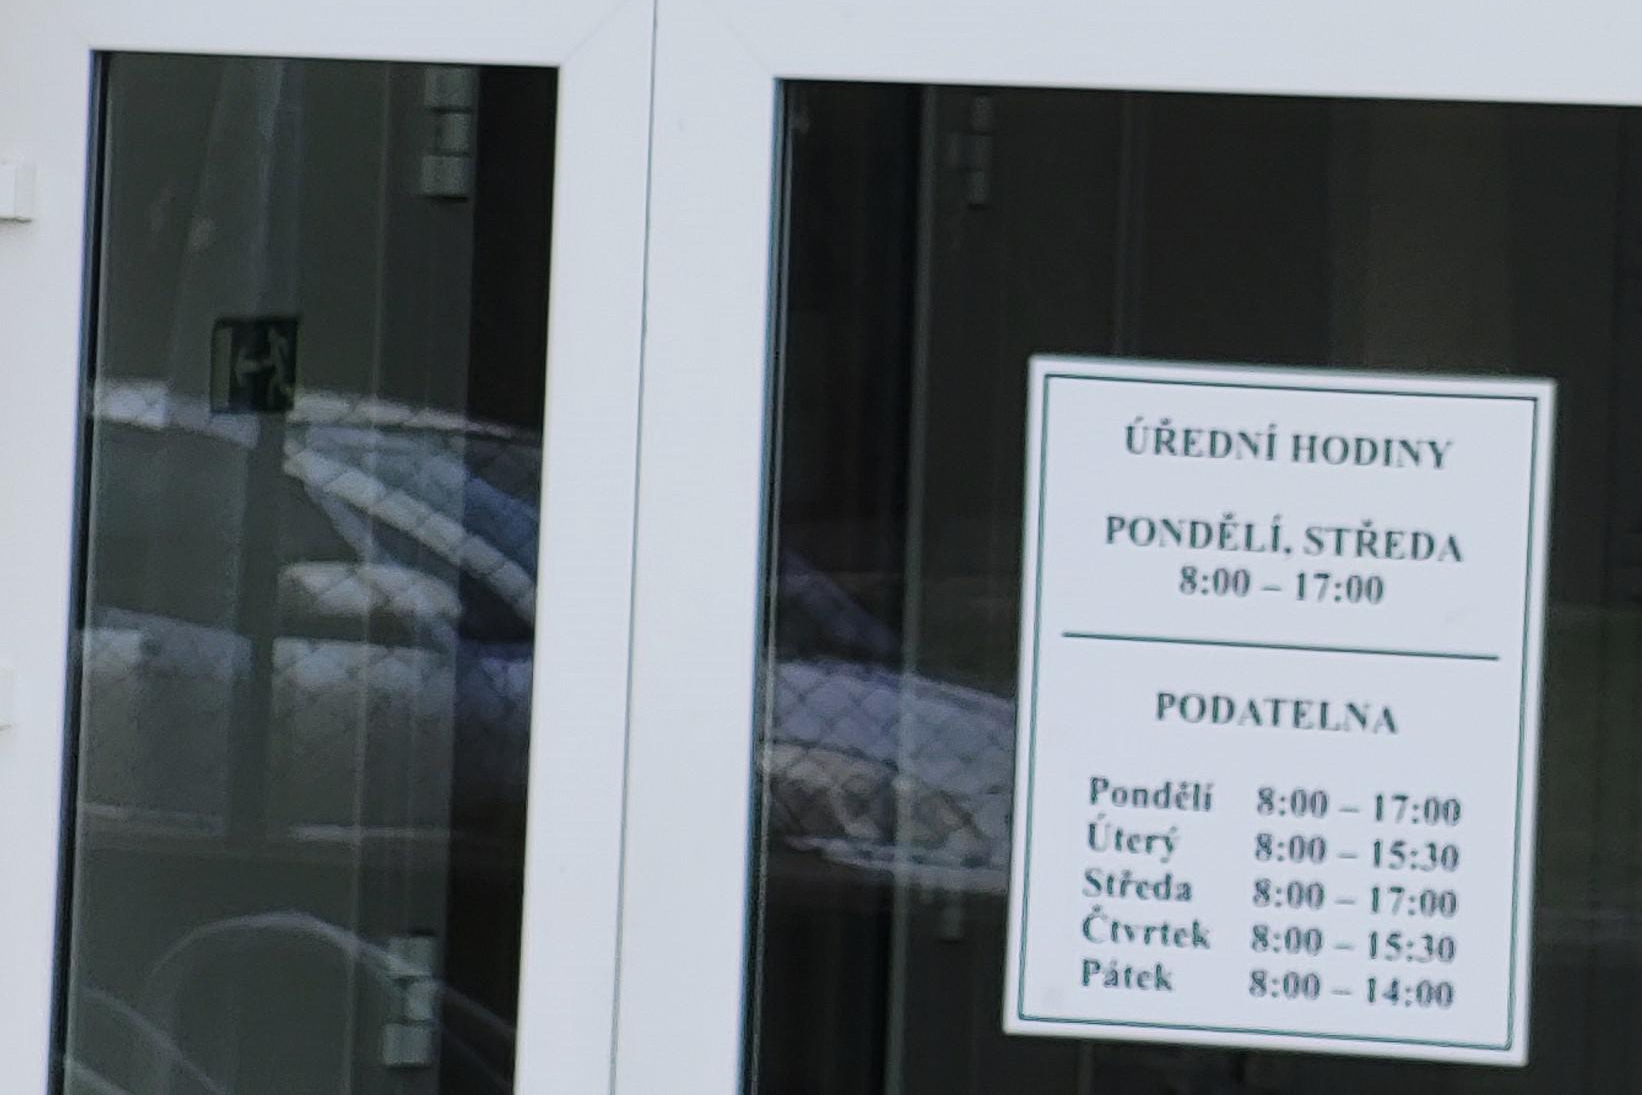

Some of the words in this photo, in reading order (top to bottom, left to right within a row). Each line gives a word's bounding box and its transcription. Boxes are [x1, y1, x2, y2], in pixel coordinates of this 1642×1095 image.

[1125, 416, 1279, 463] ÚŘEDNÍ
[1291, 433, 1454, 472] HODINY
[1106, 512, 1295, 560] PONDĚLÍ,
[1304, 519, 1465, 564] STŘEDA
[1179, 566, 1253, 599] 8:00
[1297, 571, 1387, 606] 17:00
[1156, 691, 1400, 736] PODATELNA
[1089, 776, 1216, 814] Pondělí
[1257, 787, 1331, 820] 8:00
[1375, 793, 1463, 828] 17:00
[1088, 812, 1180, 865] Úterý
[1255, 833, 1329, 866] 8:00
[1373, 838, 1462, 874] 15:30
[1082, 868, 1194, 904] Středa
[1252, 878, 1327, 912] 8:00
[1371, 885, 1461, 920] 17:00
[1082, 904, 1212, 951] Čtvrtek
[1251, 924, 1325, 958] 8:00
[1368, 930, 1458, 965] 15:30
[1081, 957, 1175, 993] Pátek
[1249, 969, 1323, 1002] 8:00
[1367, 976, 1457, 1011] 14:00
